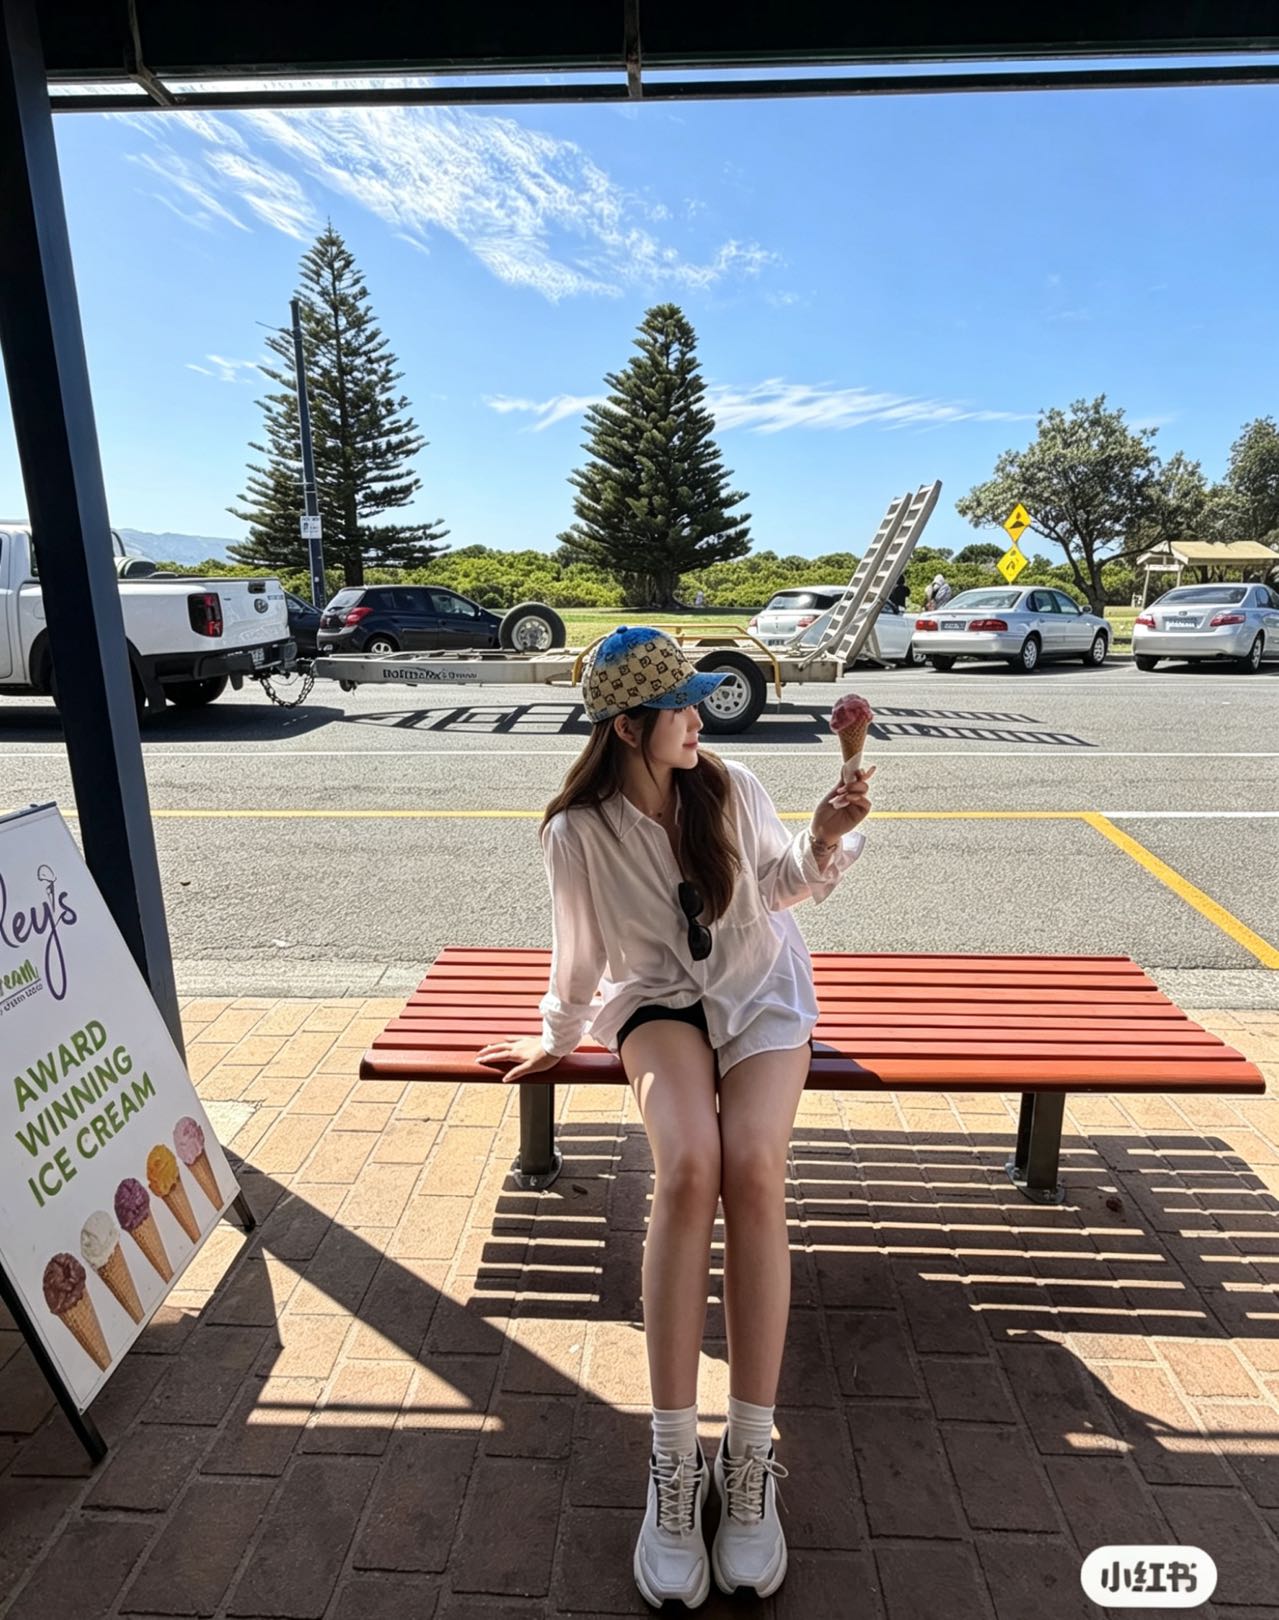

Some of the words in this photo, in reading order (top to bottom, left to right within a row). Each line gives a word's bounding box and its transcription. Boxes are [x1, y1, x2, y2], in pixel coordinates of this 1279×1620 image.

[13, 1019, 108, 1113] AWARD
[15, 1045, 133, 1158] WINNING
[28, 1146, 78, 1208] ICE
[76, 1071, 156, 1160] CREAM
